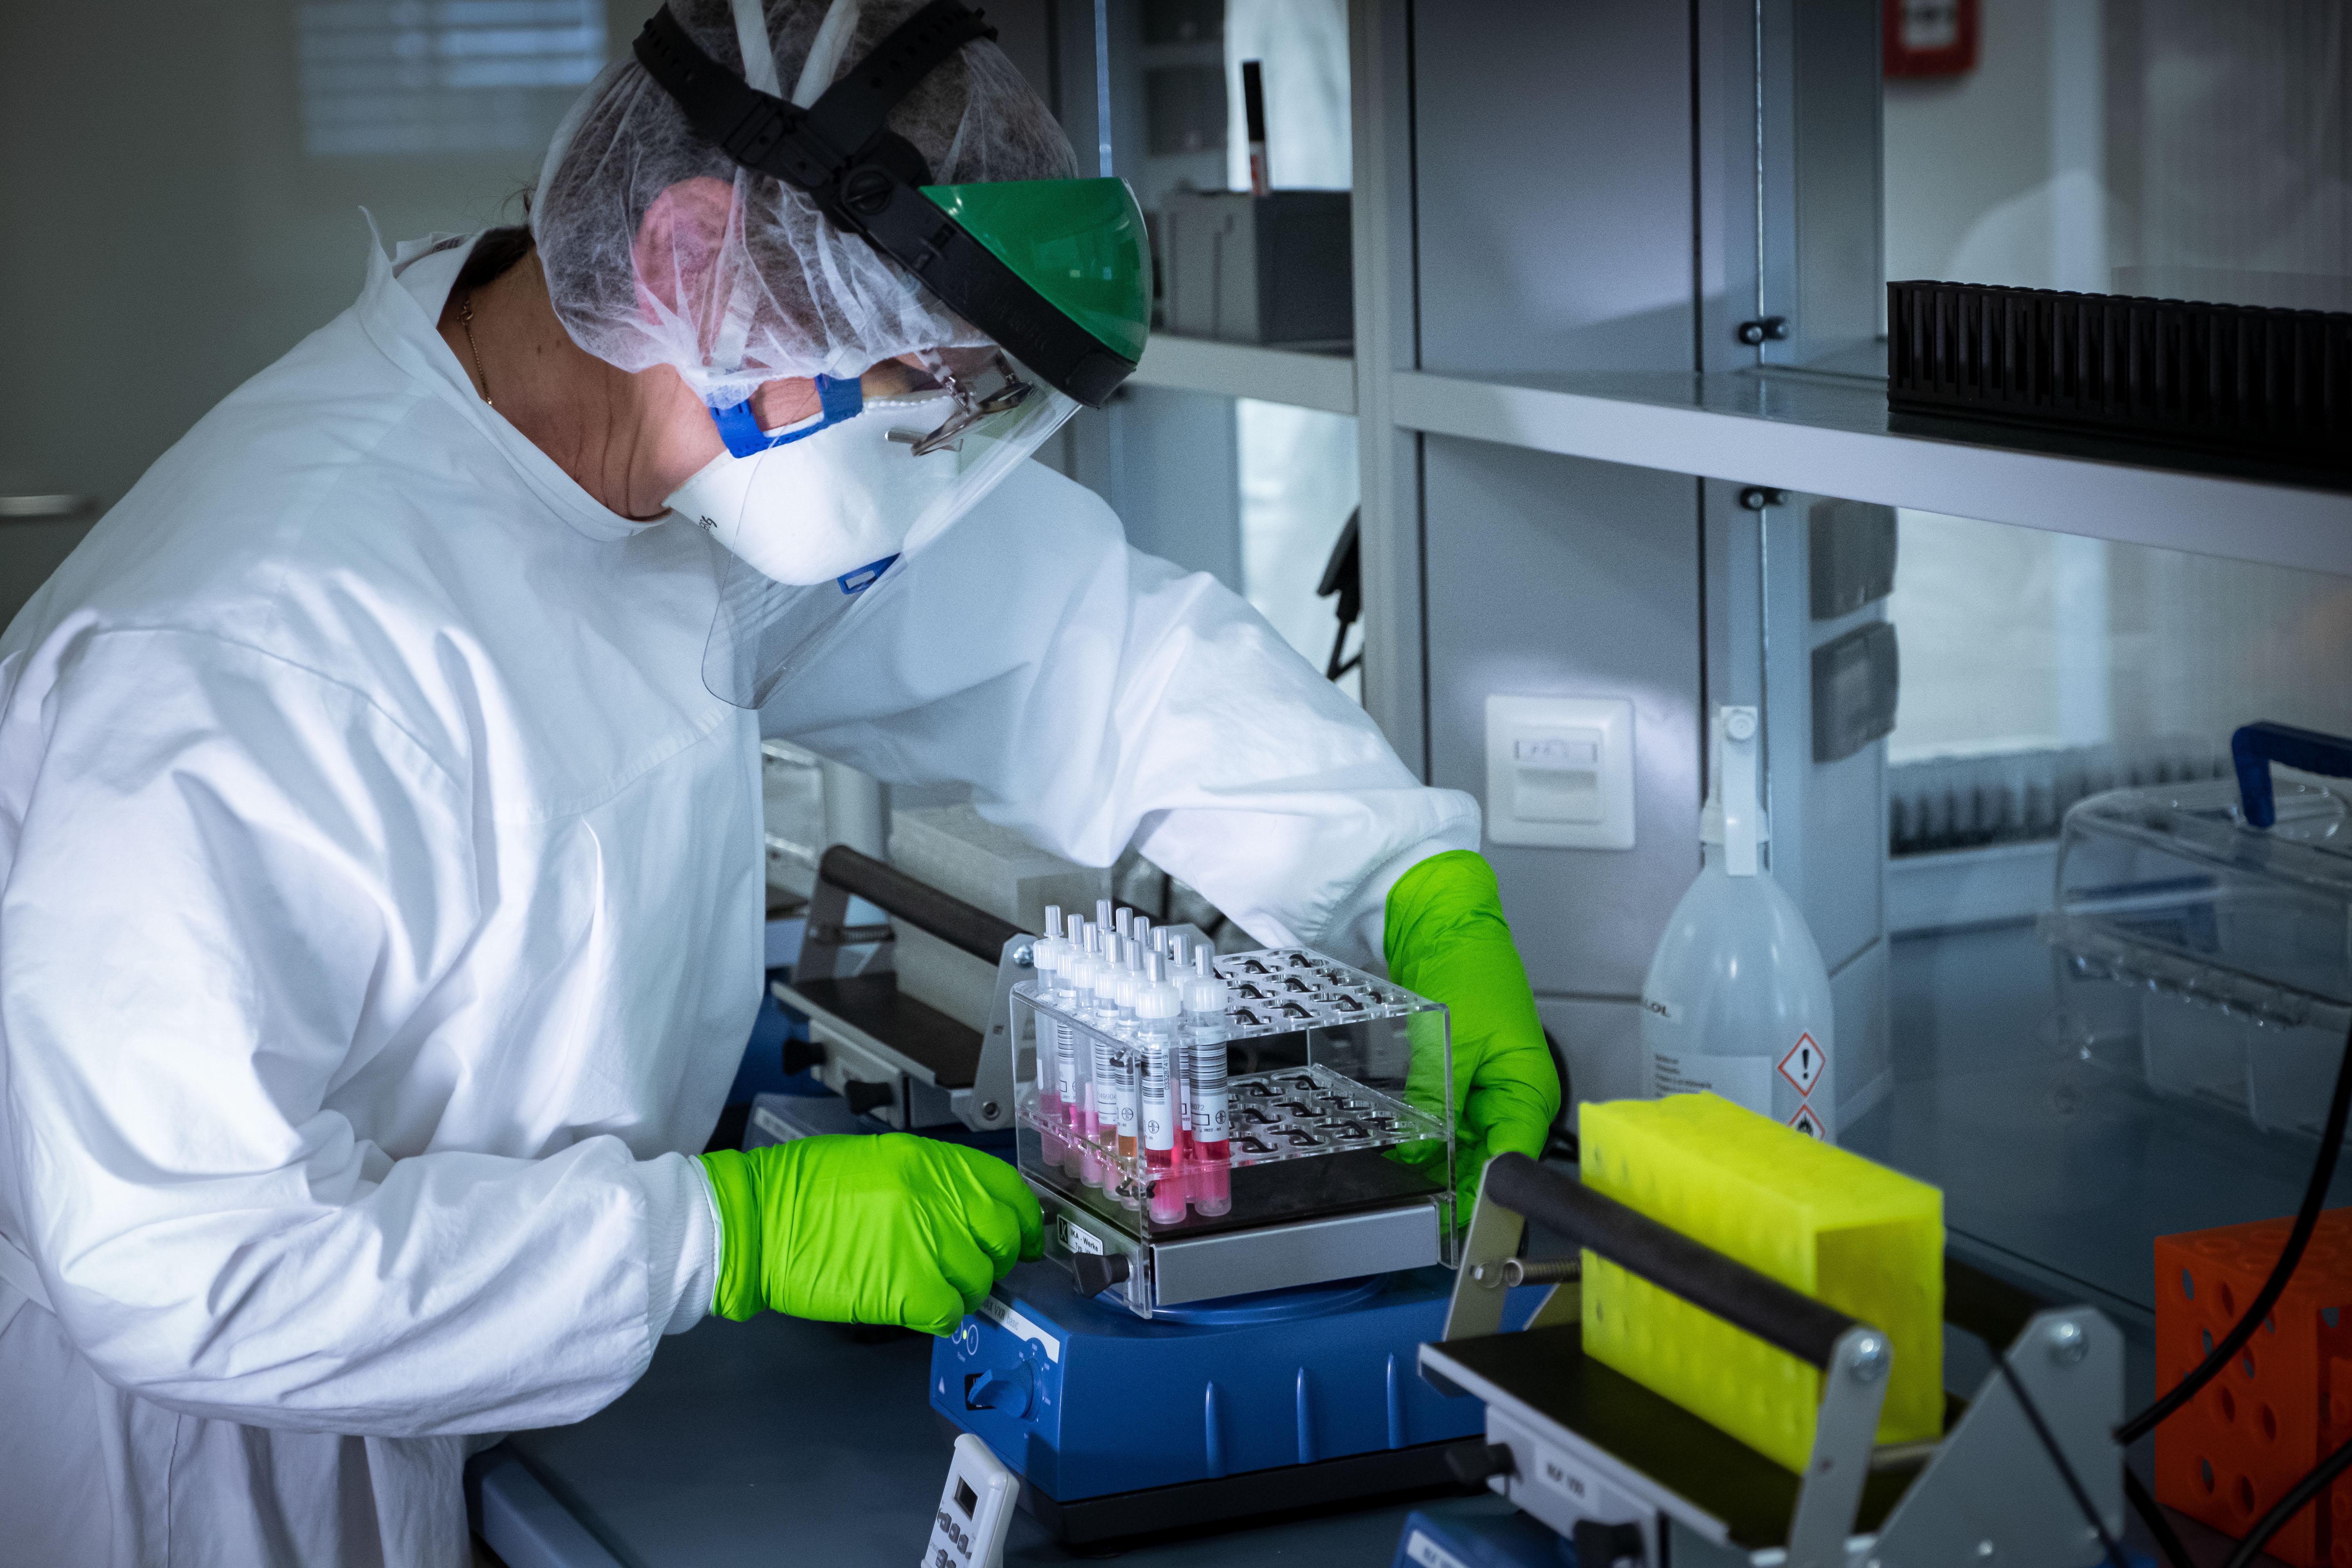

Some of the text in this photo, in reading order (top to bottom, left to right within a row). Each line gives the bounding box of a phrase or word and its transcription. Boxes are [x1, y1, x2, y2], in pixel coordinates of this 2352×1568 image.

[1071, 1229, 1079, 1240] IKA
[1083, 1236, 1098, 1252] Werke
[1007, 1313, 1019, 1330] basic
